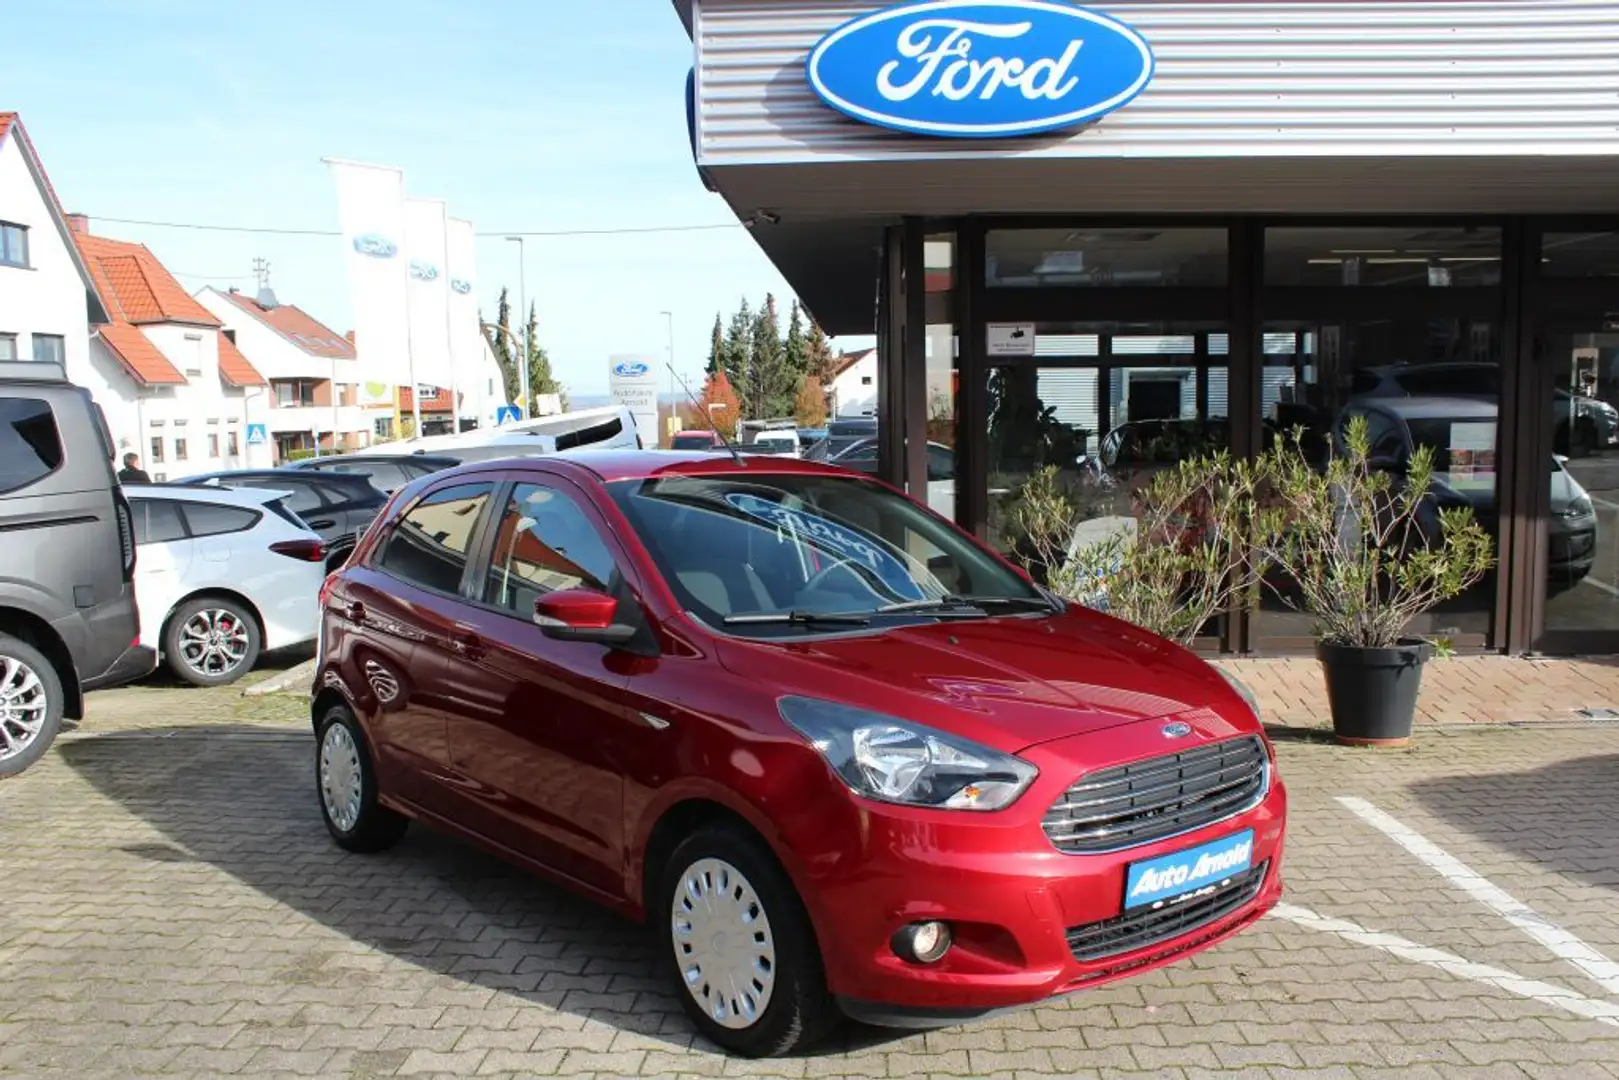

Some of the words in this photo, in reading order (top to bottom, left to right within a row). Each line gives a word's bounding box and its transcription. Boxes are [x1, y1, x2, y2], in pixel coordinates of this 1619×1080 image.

[876, 19, 1084, 101] Ford
[1130, 864, 1189, 897] Auto
[1187, 839, 1251, 881] Arnold
